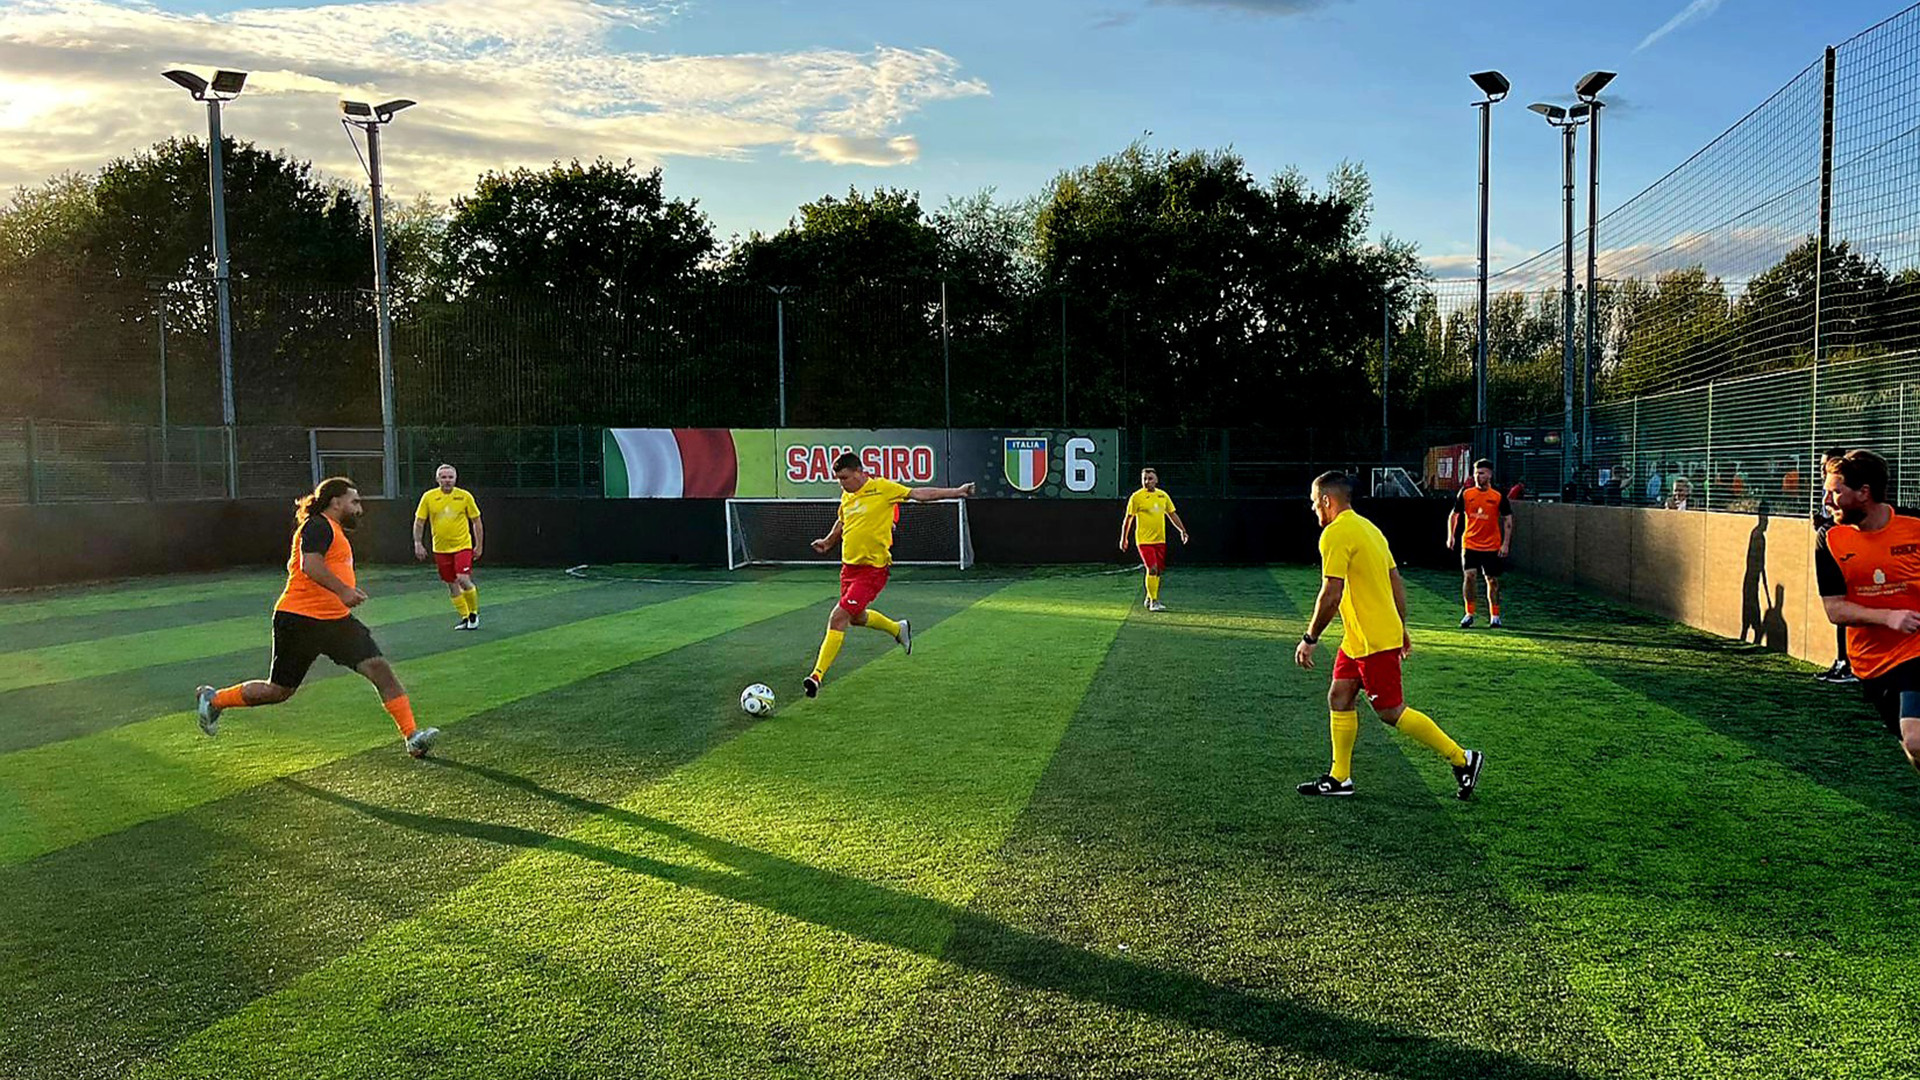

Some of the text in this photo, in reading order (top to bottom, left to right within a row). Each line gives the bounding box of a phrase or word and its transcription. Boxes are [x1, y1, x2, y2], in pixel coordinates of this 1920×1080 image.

[860, 445, 934, 482] SIRO
[1012, 441, 1040, 449] ITALIA
[1065, 437, 1096, 492] 6
